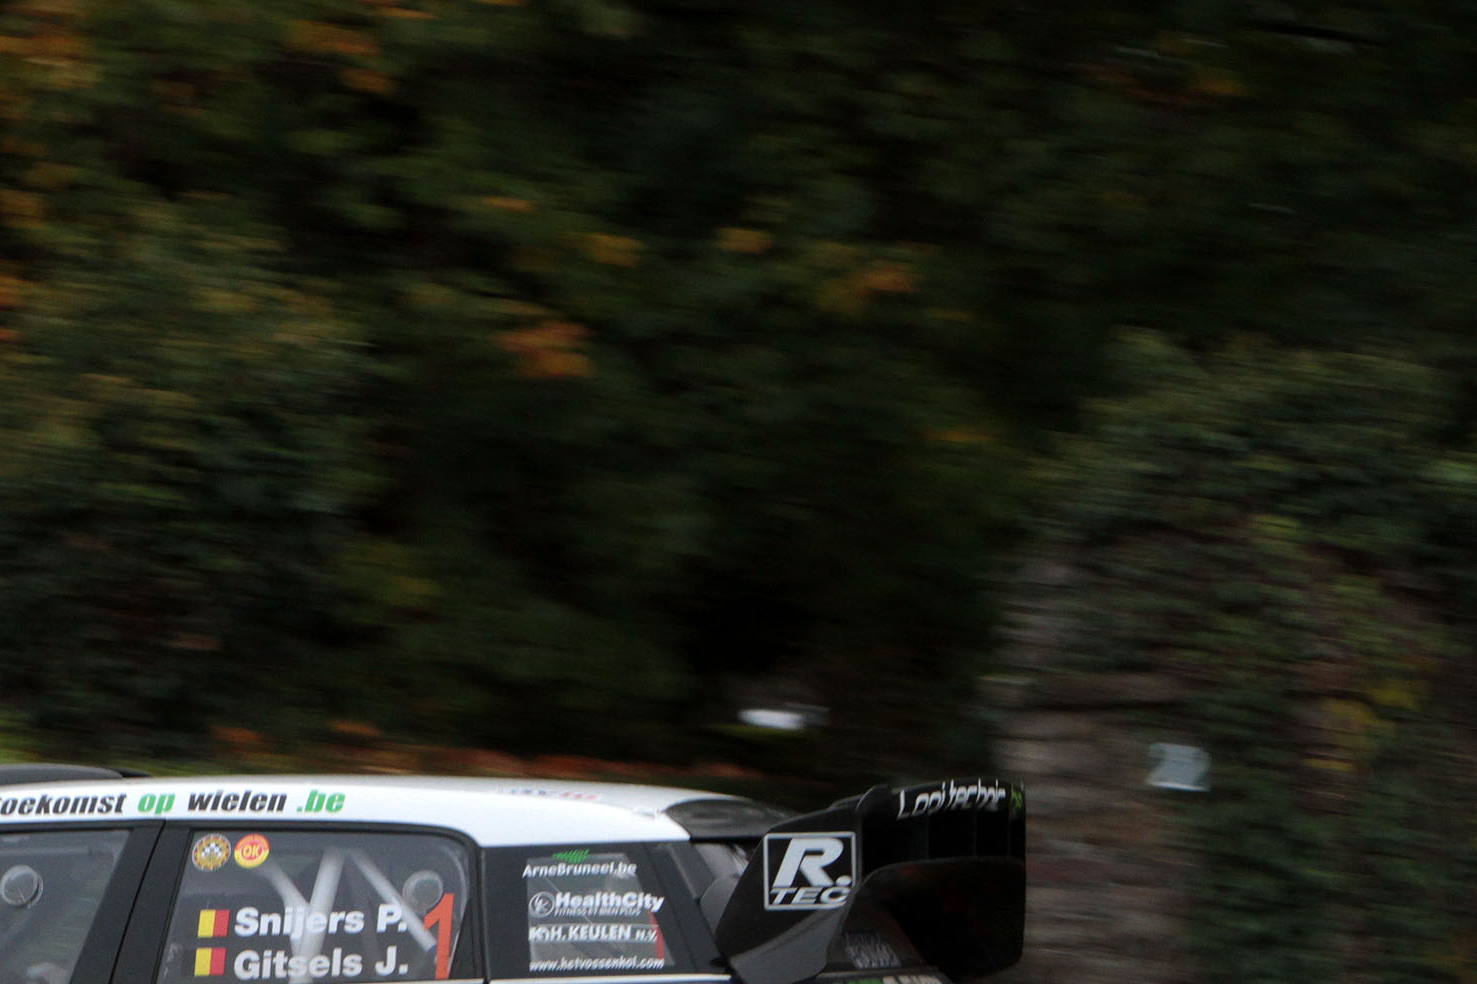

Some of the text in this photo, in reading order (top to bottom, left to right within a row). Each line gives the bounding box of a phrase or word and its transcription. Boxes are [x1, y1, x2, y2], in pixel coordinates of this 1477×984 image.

[137, 791, 176, 817] op
[186, 789, 288, 813] wielen
[242, 842, 262, 858] OK
[554, 890, 666, 913] HealthCity
[770, 886, 852, 905] TEC
[234, 902, 409, 942] Snijers P.
[424, 892, 456, 980] 1
[233, 945, 409, 981] Gitsels J.
